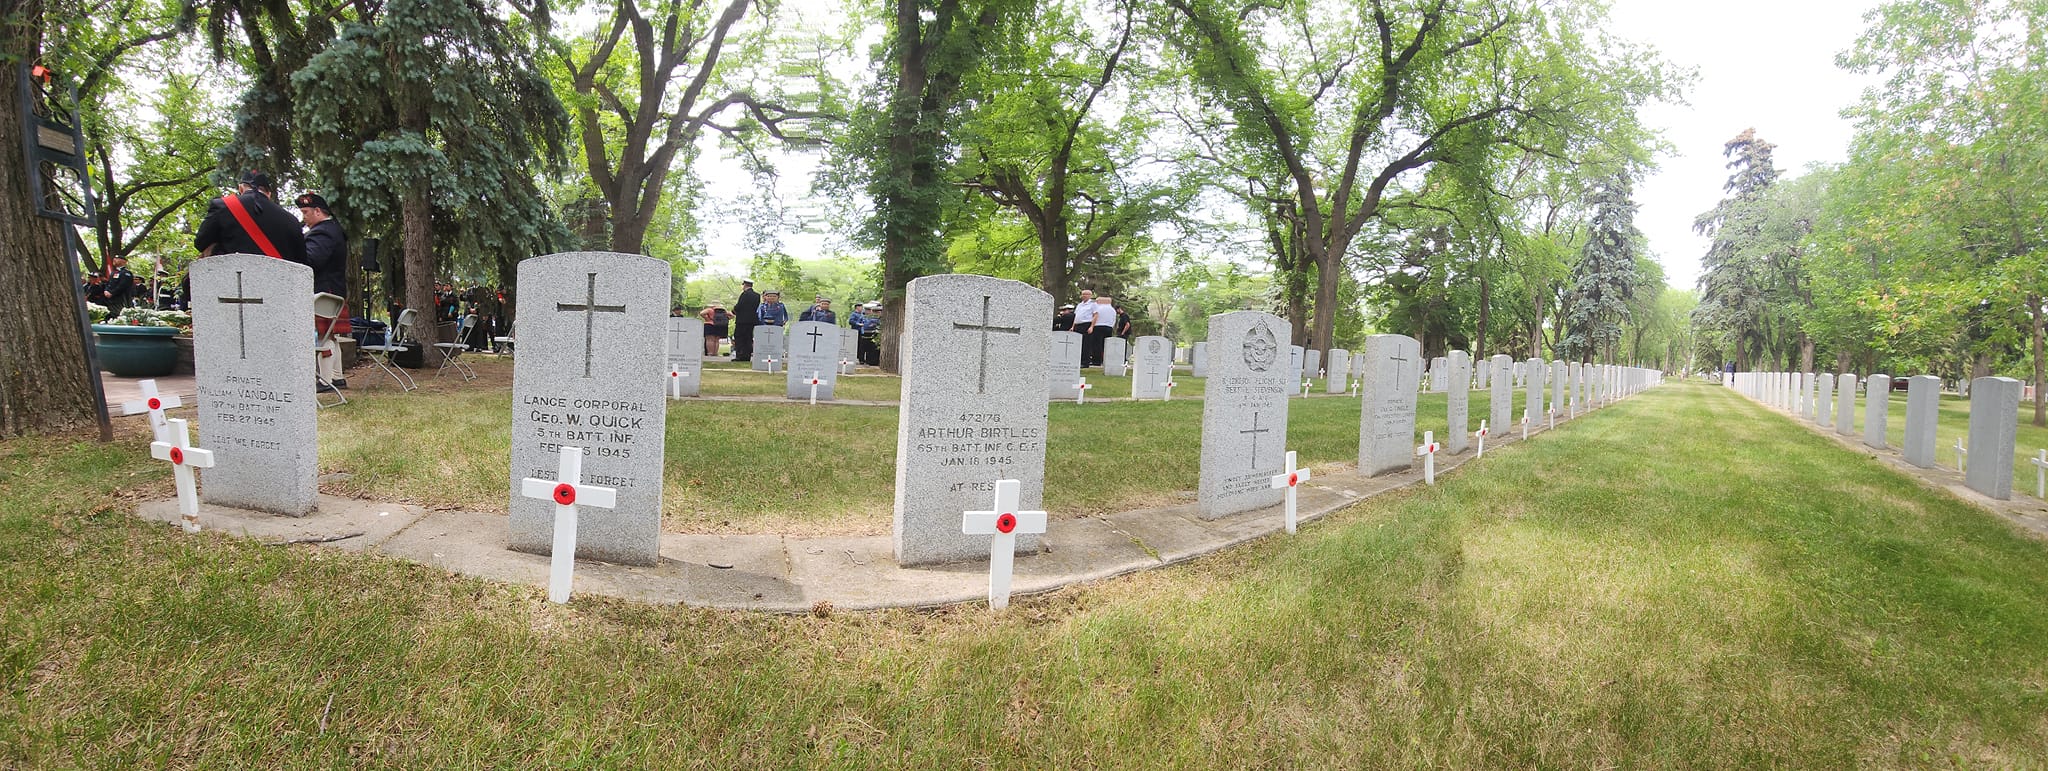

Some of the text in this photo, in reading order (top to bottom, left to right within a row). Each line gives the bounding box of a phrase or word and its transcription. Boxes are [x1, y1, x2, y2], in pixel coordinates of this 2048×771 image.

[226, 376, 262, 386] PRIVATE
[238, 388, 293, 402] VANDALE
[524, 395, 646, 412] LANCE CORPORAL
[239, 415, 251, 424] 27
[254, 416, 276, 426] 1945
[566, 414, 582, 426] W.
[589, 414, 642, 429] QUICK
[566, 430, 605, 442] BATT.
[610, 433, 636, 444] INF.
[918, 428, 1038, 438] ARTHUR BIRTLES
[598, 447, 630, 458] 1945
[950, 482, 996, 492] AT RES
